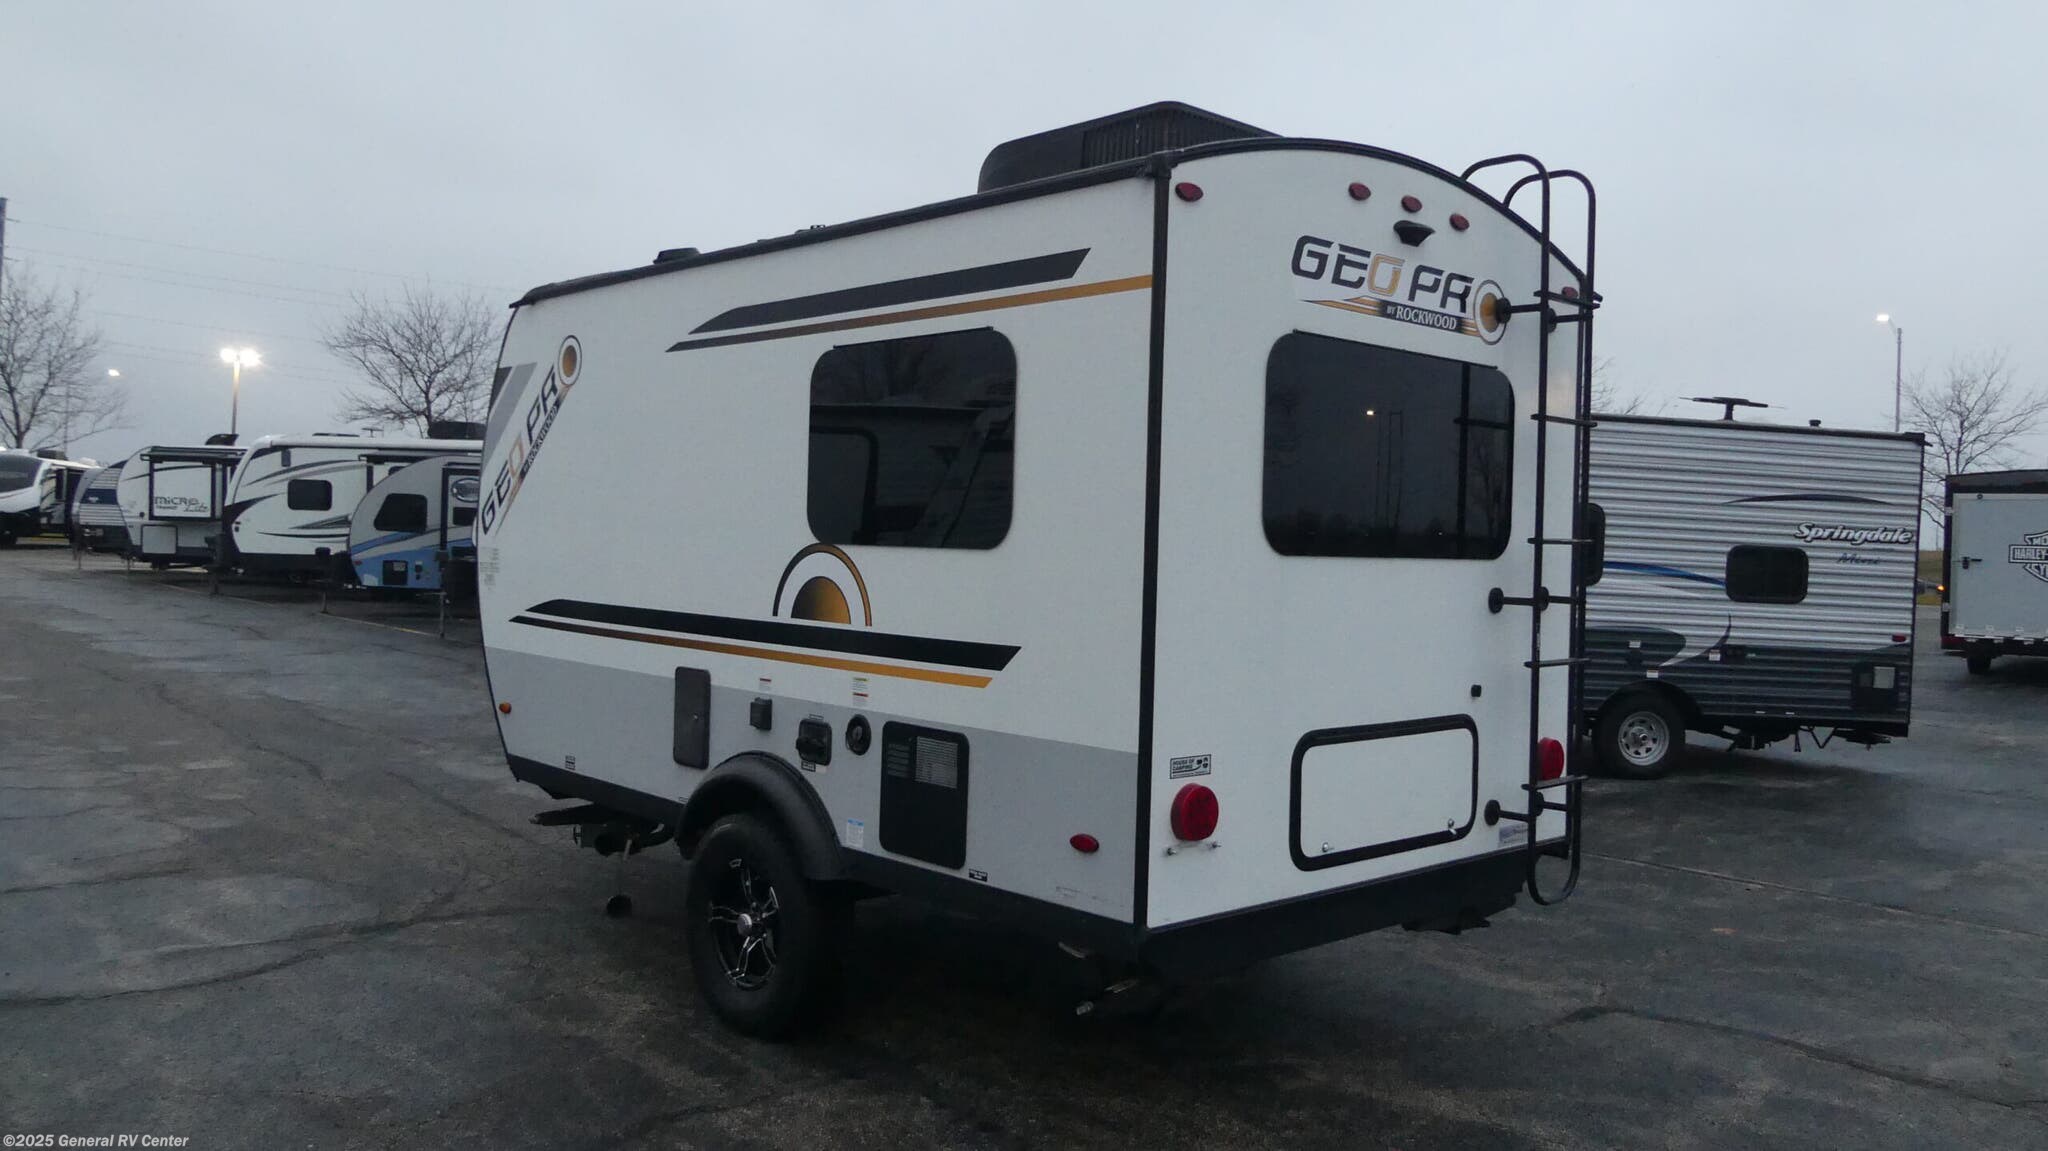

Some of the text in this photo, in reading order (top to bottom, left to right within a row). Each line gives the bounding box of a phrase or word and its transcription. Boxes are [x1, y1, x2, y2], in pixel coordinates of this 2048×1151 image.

[1291, 235, 1405, 297] GEO
[1395, 307, 1457, 330] ROCKWOOD
[481, 432, 525, 535] GEO
[1793, 521, 1914, 546] Springdale
